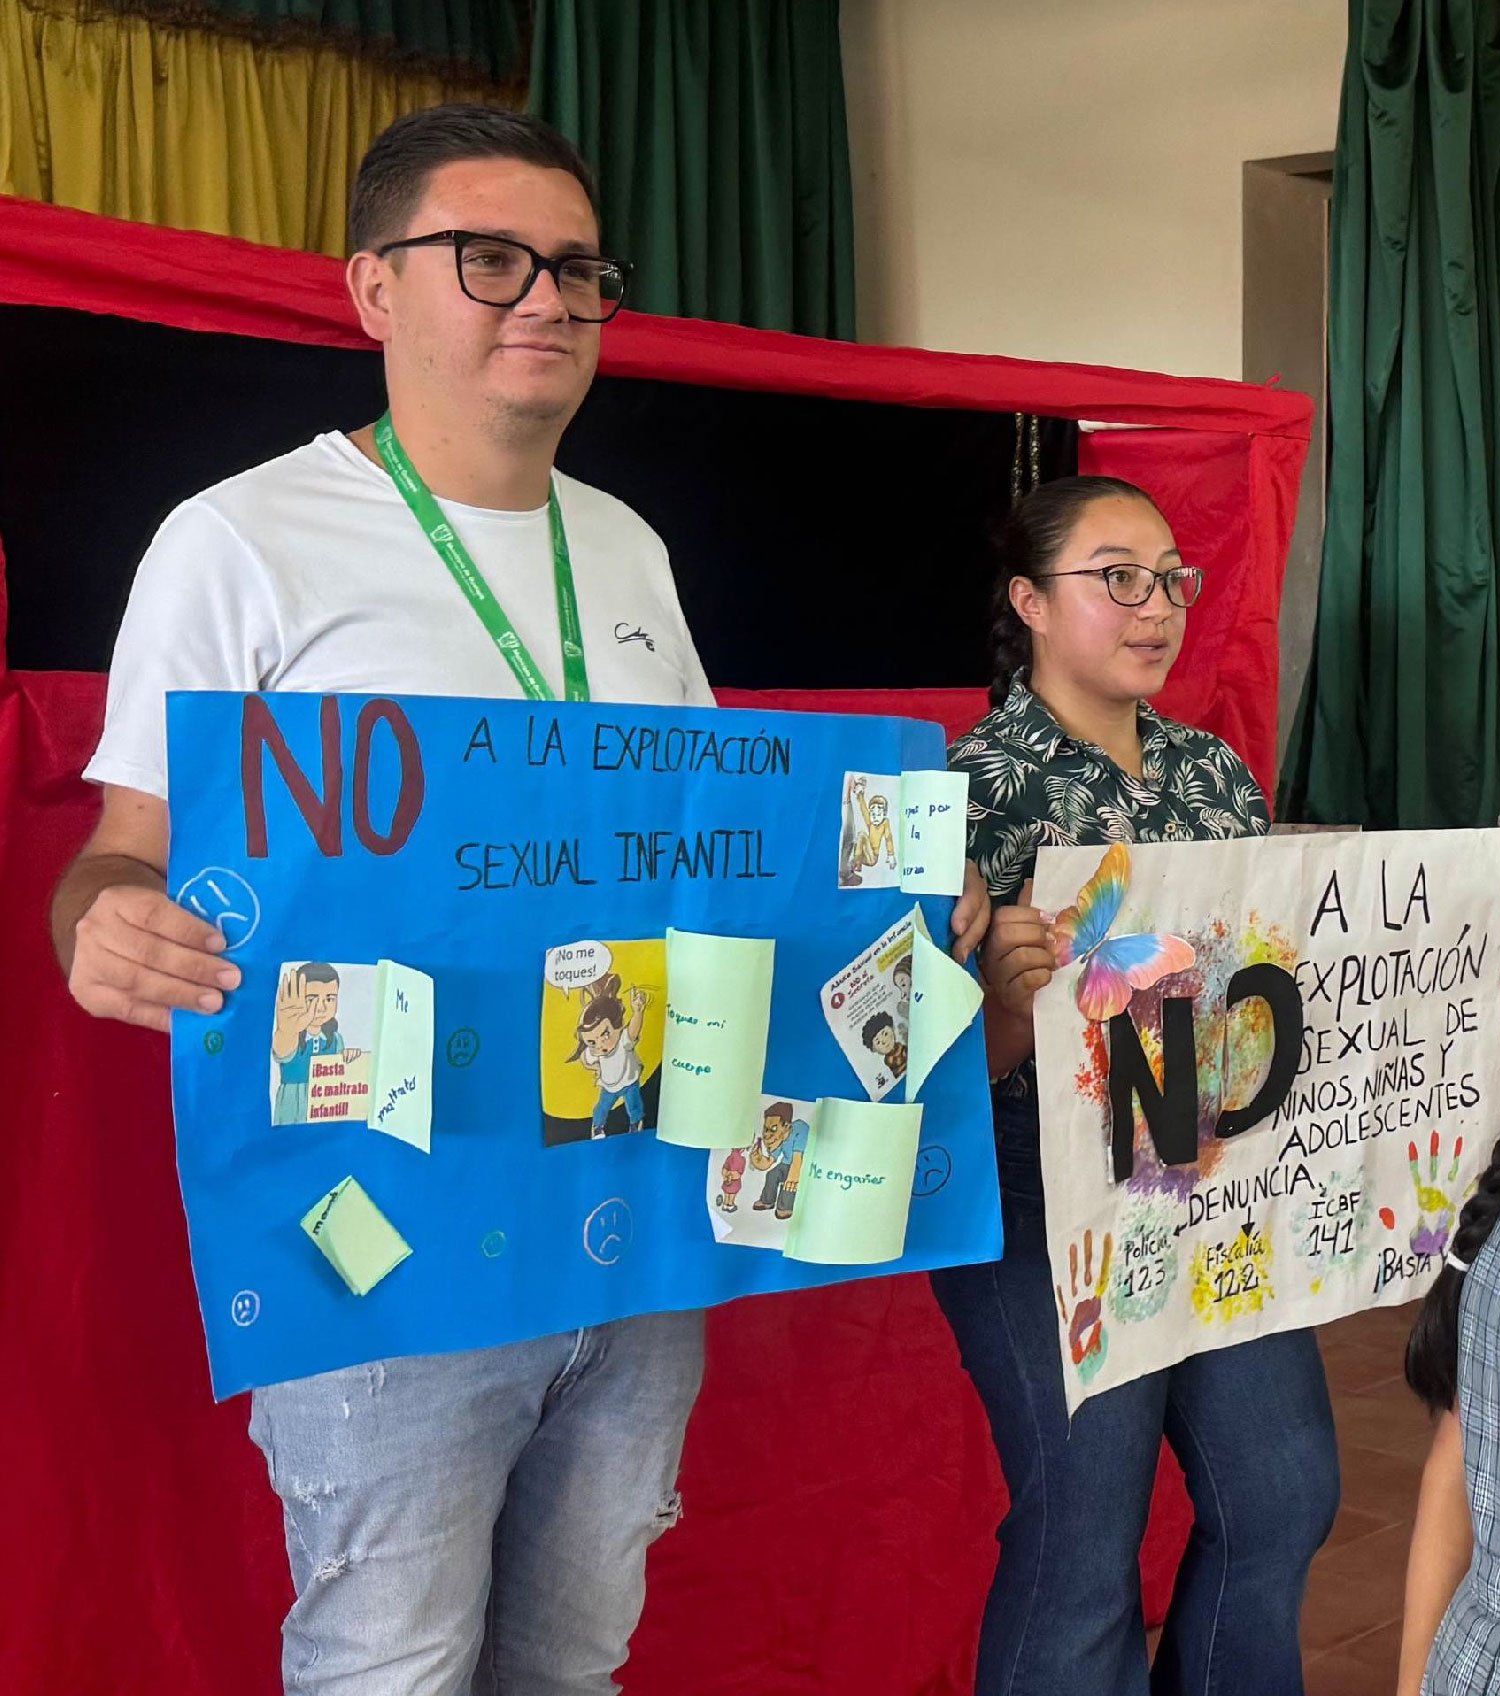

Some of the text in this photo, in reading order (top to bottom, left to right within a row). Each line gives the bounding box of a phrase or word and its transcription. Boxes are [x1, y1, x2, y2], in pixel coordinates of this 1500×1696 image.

[241, 693, 425, 858] NO
[463, 715, 791, 776] A LA EXPLOTACIÓN
[455, 829, 778, 890] SEXUAL INFANTIL
[1310, 859, 1430, 936] A LA
[554, 964, 597, 982] toques!
[576, 947, 595, 959] me
[1294, 923, 1488, 1022] EXPLOTACIÓN
[1296, 997, 1478, 1075] SEXUAL DE
[311, 1082, 369, 1098] de maltrato
[1108, 962, 1304, 1185] NO
[1363, 1052, 1425, 1104] NIÑAS
[1440, 1039, 1454, 1078] Y
[1278, 1072, 1480, 1163] ADOLESCENTES
[1308, 1191, 1361, 1220] ICBF
[1308, 1217, 1354, 1257] 141
[1123, 1258, 1166, 1298] 123
[1213, 1263, 1259, 1303] 122
[1373, 1247, 1432, 1294] ¡BASTA
